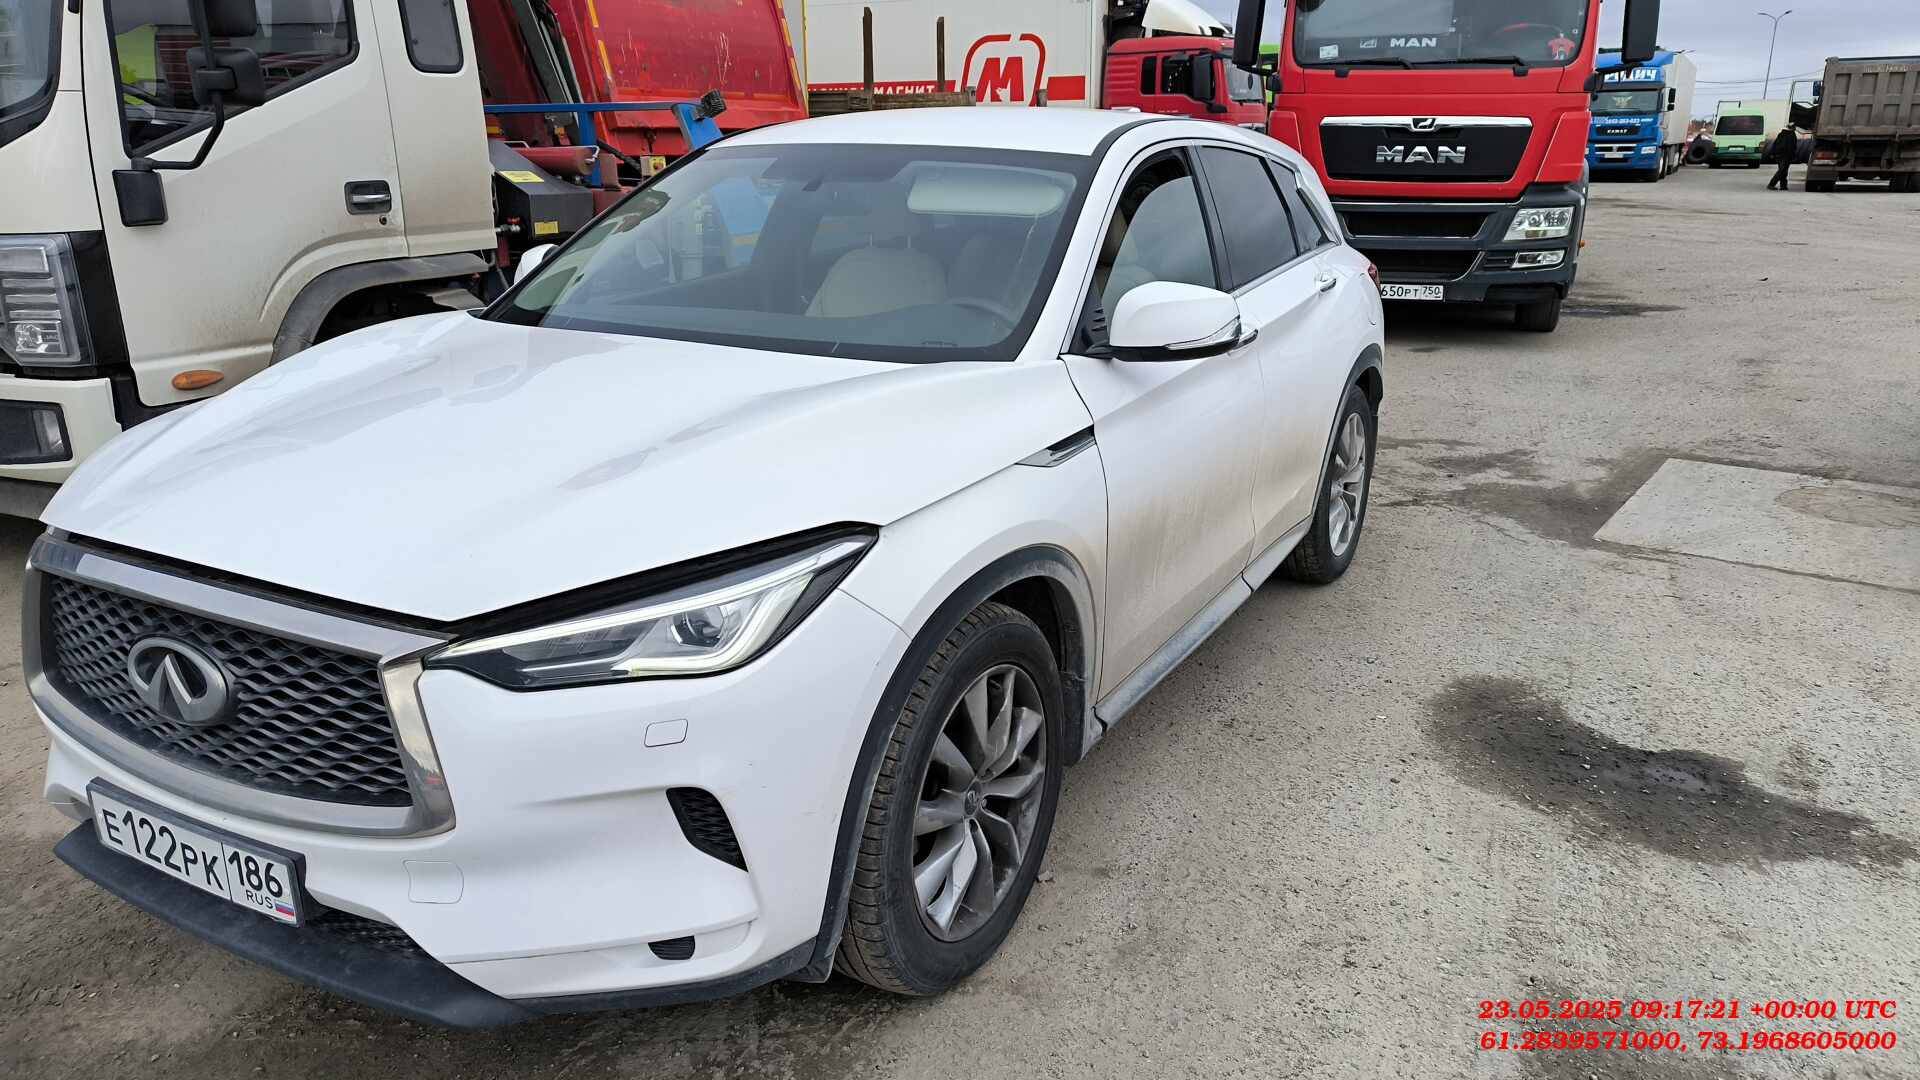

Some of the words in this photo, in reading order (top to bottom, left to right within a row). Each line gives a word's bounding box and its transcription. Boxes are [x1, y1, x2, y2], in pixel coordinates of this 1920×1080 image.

[1390, 37, 1437, 48] MAN
[1376, 145, 1466, 163] MAN
[1381, 286, 1420, 297] 650РТ
[1422, 286, 1440, 296] 750
[228, 850, 283, 898] 186
[246, 890, 274, 910] RUS
